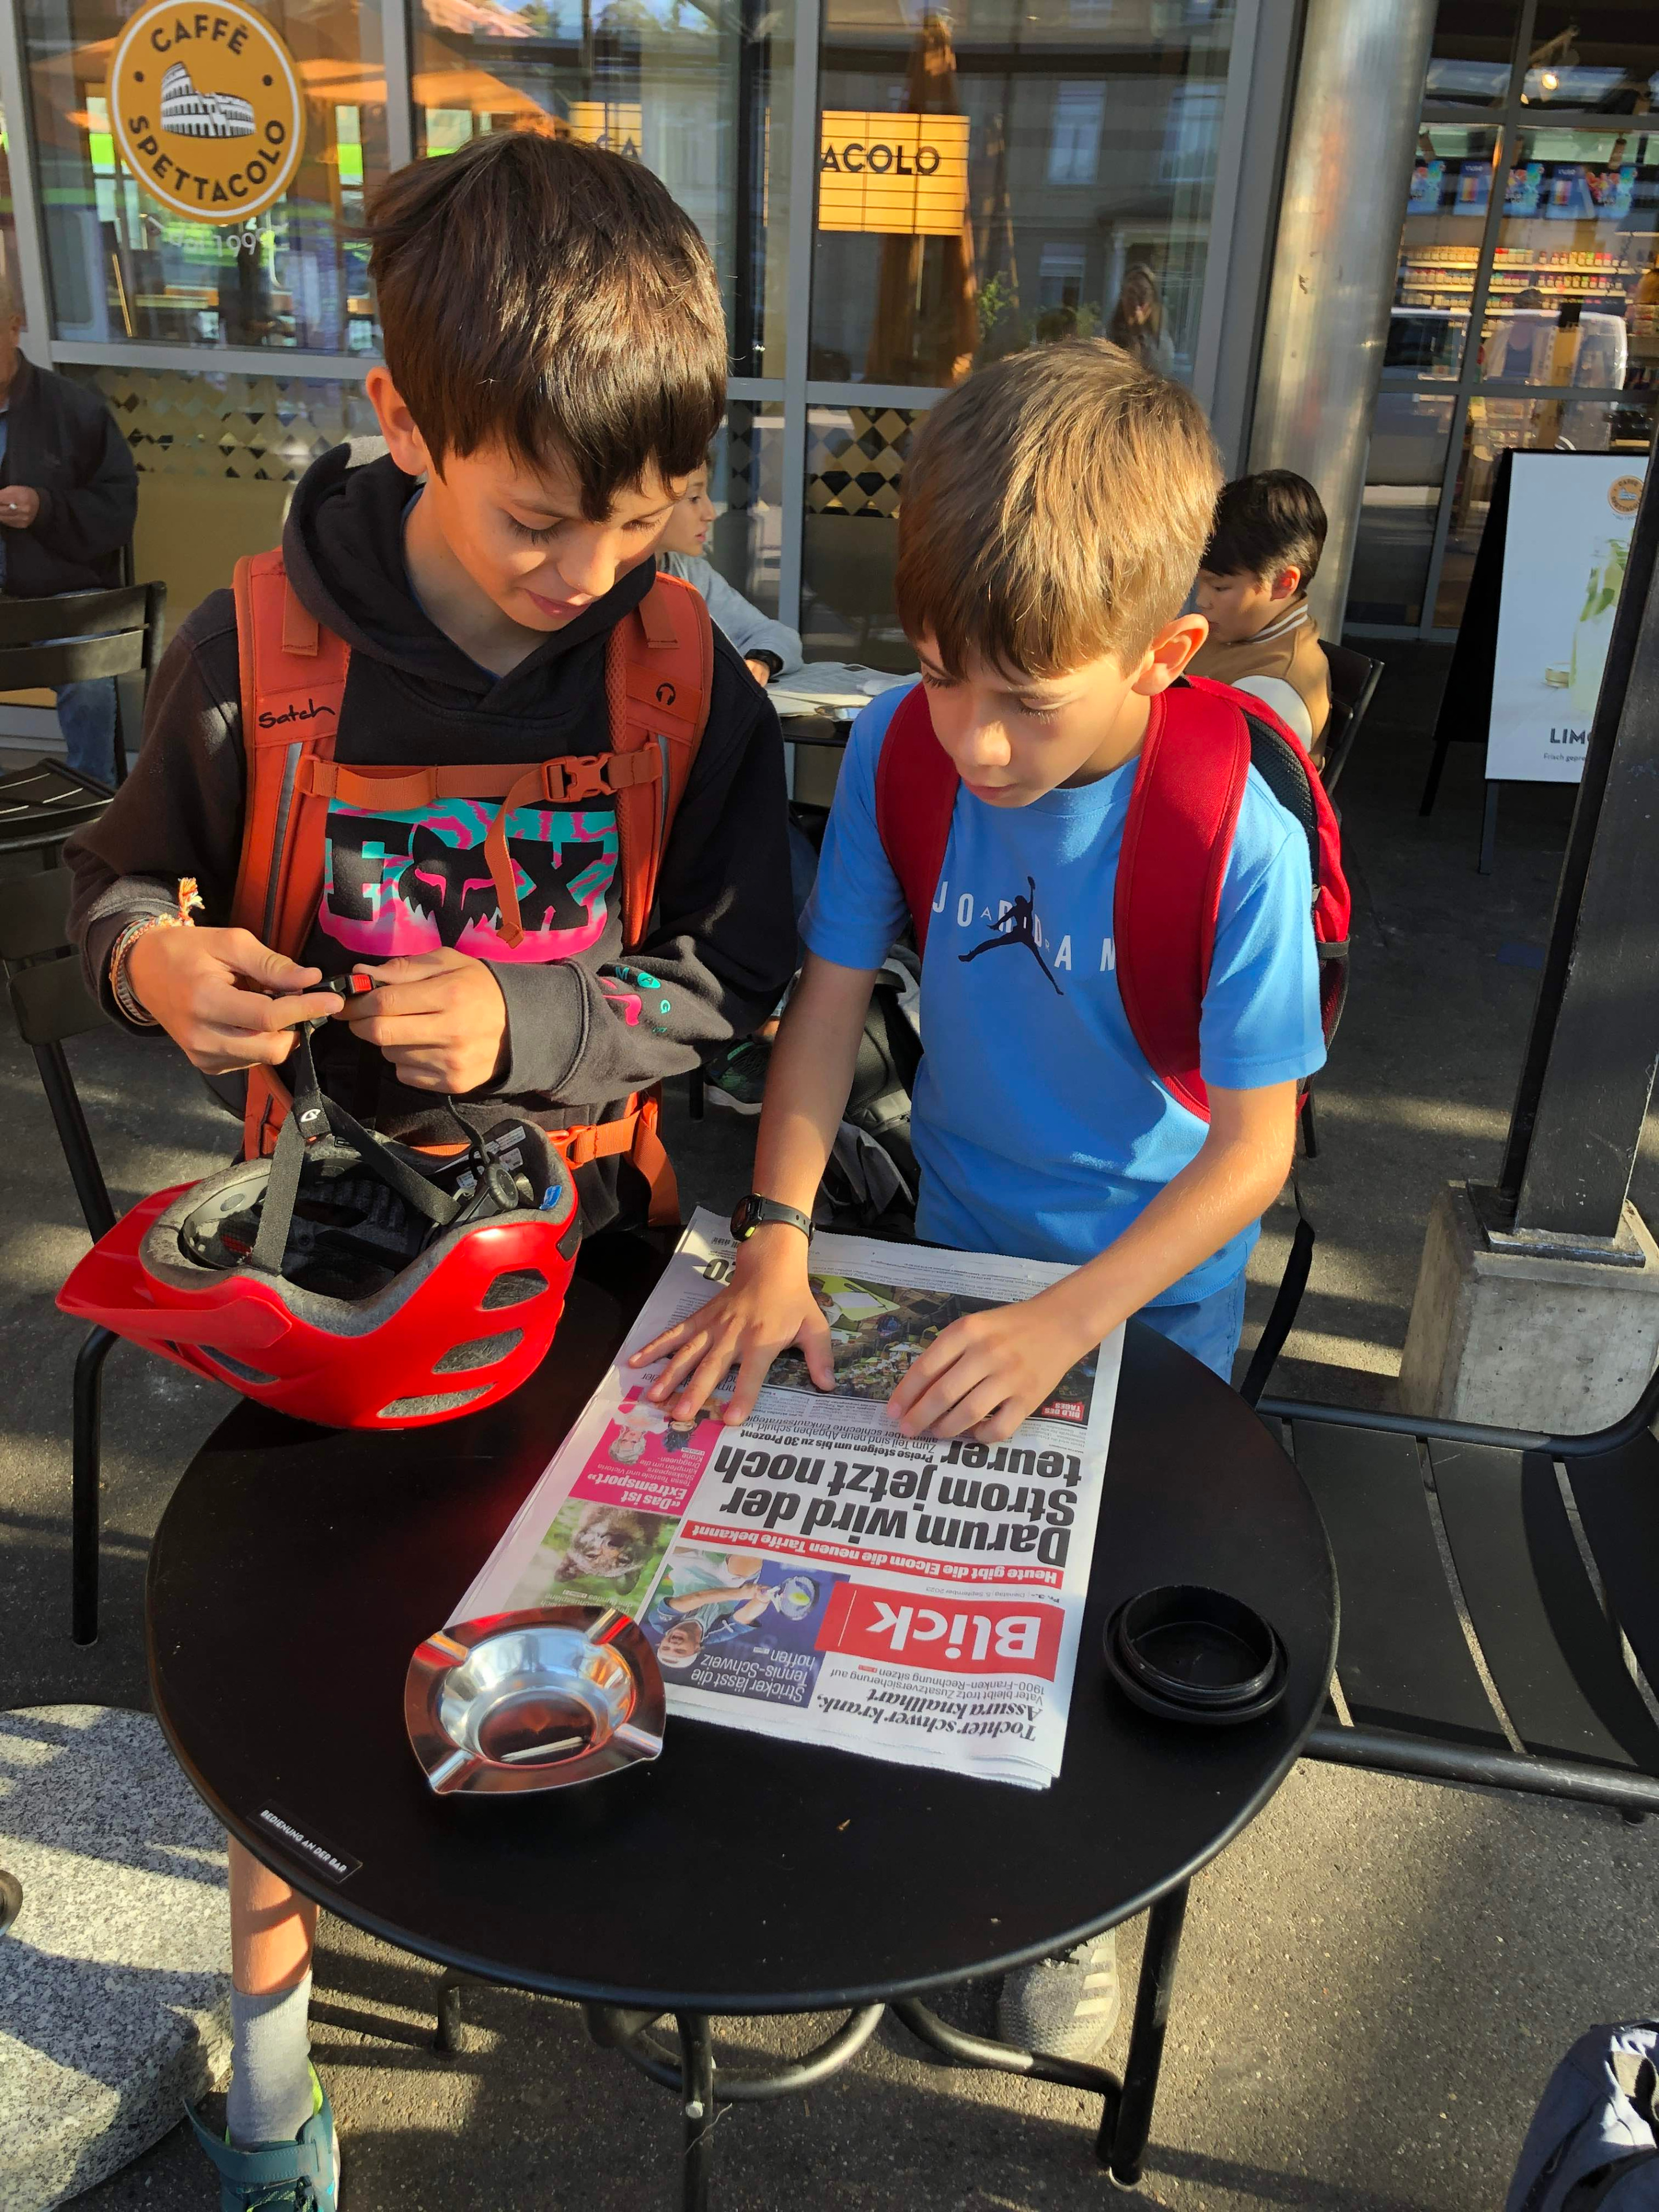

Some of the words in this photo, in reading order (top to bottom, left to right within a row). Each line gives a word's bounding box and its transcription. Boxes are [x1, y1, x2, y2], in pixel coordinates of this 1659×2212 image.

[150, 14, 249, 55] CAFFÈ
[127, 115, 287, 203] SPETTACOLO
[1044, 1407, 1060, 1415] DES
[1055, 1403, 1081, 1412] TAGES
[1061, 1409, 1080, 1418] BILD
[740, 1429, 783, 1445] Prozent
[793, 1426, 839, 1440] Abgaben
[833, 1424, 882, 1437] schlechte
[840, 1432, 866, 1442] neue
[786, 1435, 798, 1446] 30
[799, 1436, 815, 1446] zu
[816, 1439, 831, 1450] bis
[834, 1441, 852, 1451] um
[868, 1435, 890, 1446] sind
[892, 1439, 909, 1449] Teil
[912, 1441, 937, 1453] Zum
[681, 1452, 703, 1462] Krone
[854, 1443, 896, 1457] steigen
[897, 1450, 933, 1463] Preise
[597, 1463, 625, 1475] Victoria
[657, 1456, 700, 1469] Dragqueen-
[665, 1463, 698, 1475] kämpfen
[714, 1445, 825, 1486] noch
[940, 1440, 1082, 1488] teurer
[626, 1469, 641, 1477] und
[587, 1473, 687, 1500] Extremsport»
[827, 1461, 938, 1511] jetzt
[620, 1490, 643, 1505] ist
[644, 1495, 681, 1510] «Das
[937, 1476, 1077, 1527] Strom
[719, 1487, 801, 1529] der
[800, 1497, 908, 1545] wird
[692, 1525, 759, 1541] bekannt
[760, 1534, 806, 1553] Tarife
[915, 1514, 1071, 1569] Darum
[809, 1542, 860, 1560] neuen
[861, 1551, 887, 1566] die
[890, 1555, 941, 1575] Elcom
[943, 1564, 969, 1579] die
[971, 1566, 1005, 1580] gibt
[1007, 1569, 1057, 1584] Heute
[944, 1589, 983, 1597] September
[865, 1601, 1041, 1660] Blick
[770, 1649, 815, 1671] hoffen
[691, 1668, 713, 1687] die
[700, 1654, 807, 1687] Tennis-Schweiz
[829, 1668, 848, 1677] auf
[878, 1668, 910, 1681] sitzen
[713, 1673, 749, 1693] lässt
[850, 1671, 955, 1699] Zusatzversicherung
[912, 1672, 1045, 1695] 1900-Franken-Rechnung
[749, 1680, 804, 1703] Stricker
[956, 1689, 980, 1700] trotz
[983, 1690, 1013, 1703] bleibt
[1014, 1691, 1043, 1705] Vater
[816, 1694, 884, 1724] krank,
[866, 1688, 968, 1719] knallhart
[969, 1703, 1043, 1721] Assura
[884, 1711, 957, 1736] schwer
[957, 1719, 1036, 1742] Tochter
[260, 1809, 304, 1842] BEDIENUNG
[301, 1840, 317, 1851] AN
[313, 1847, 331, 1862] DER
[328, 1858, 347, 1873] BAR
